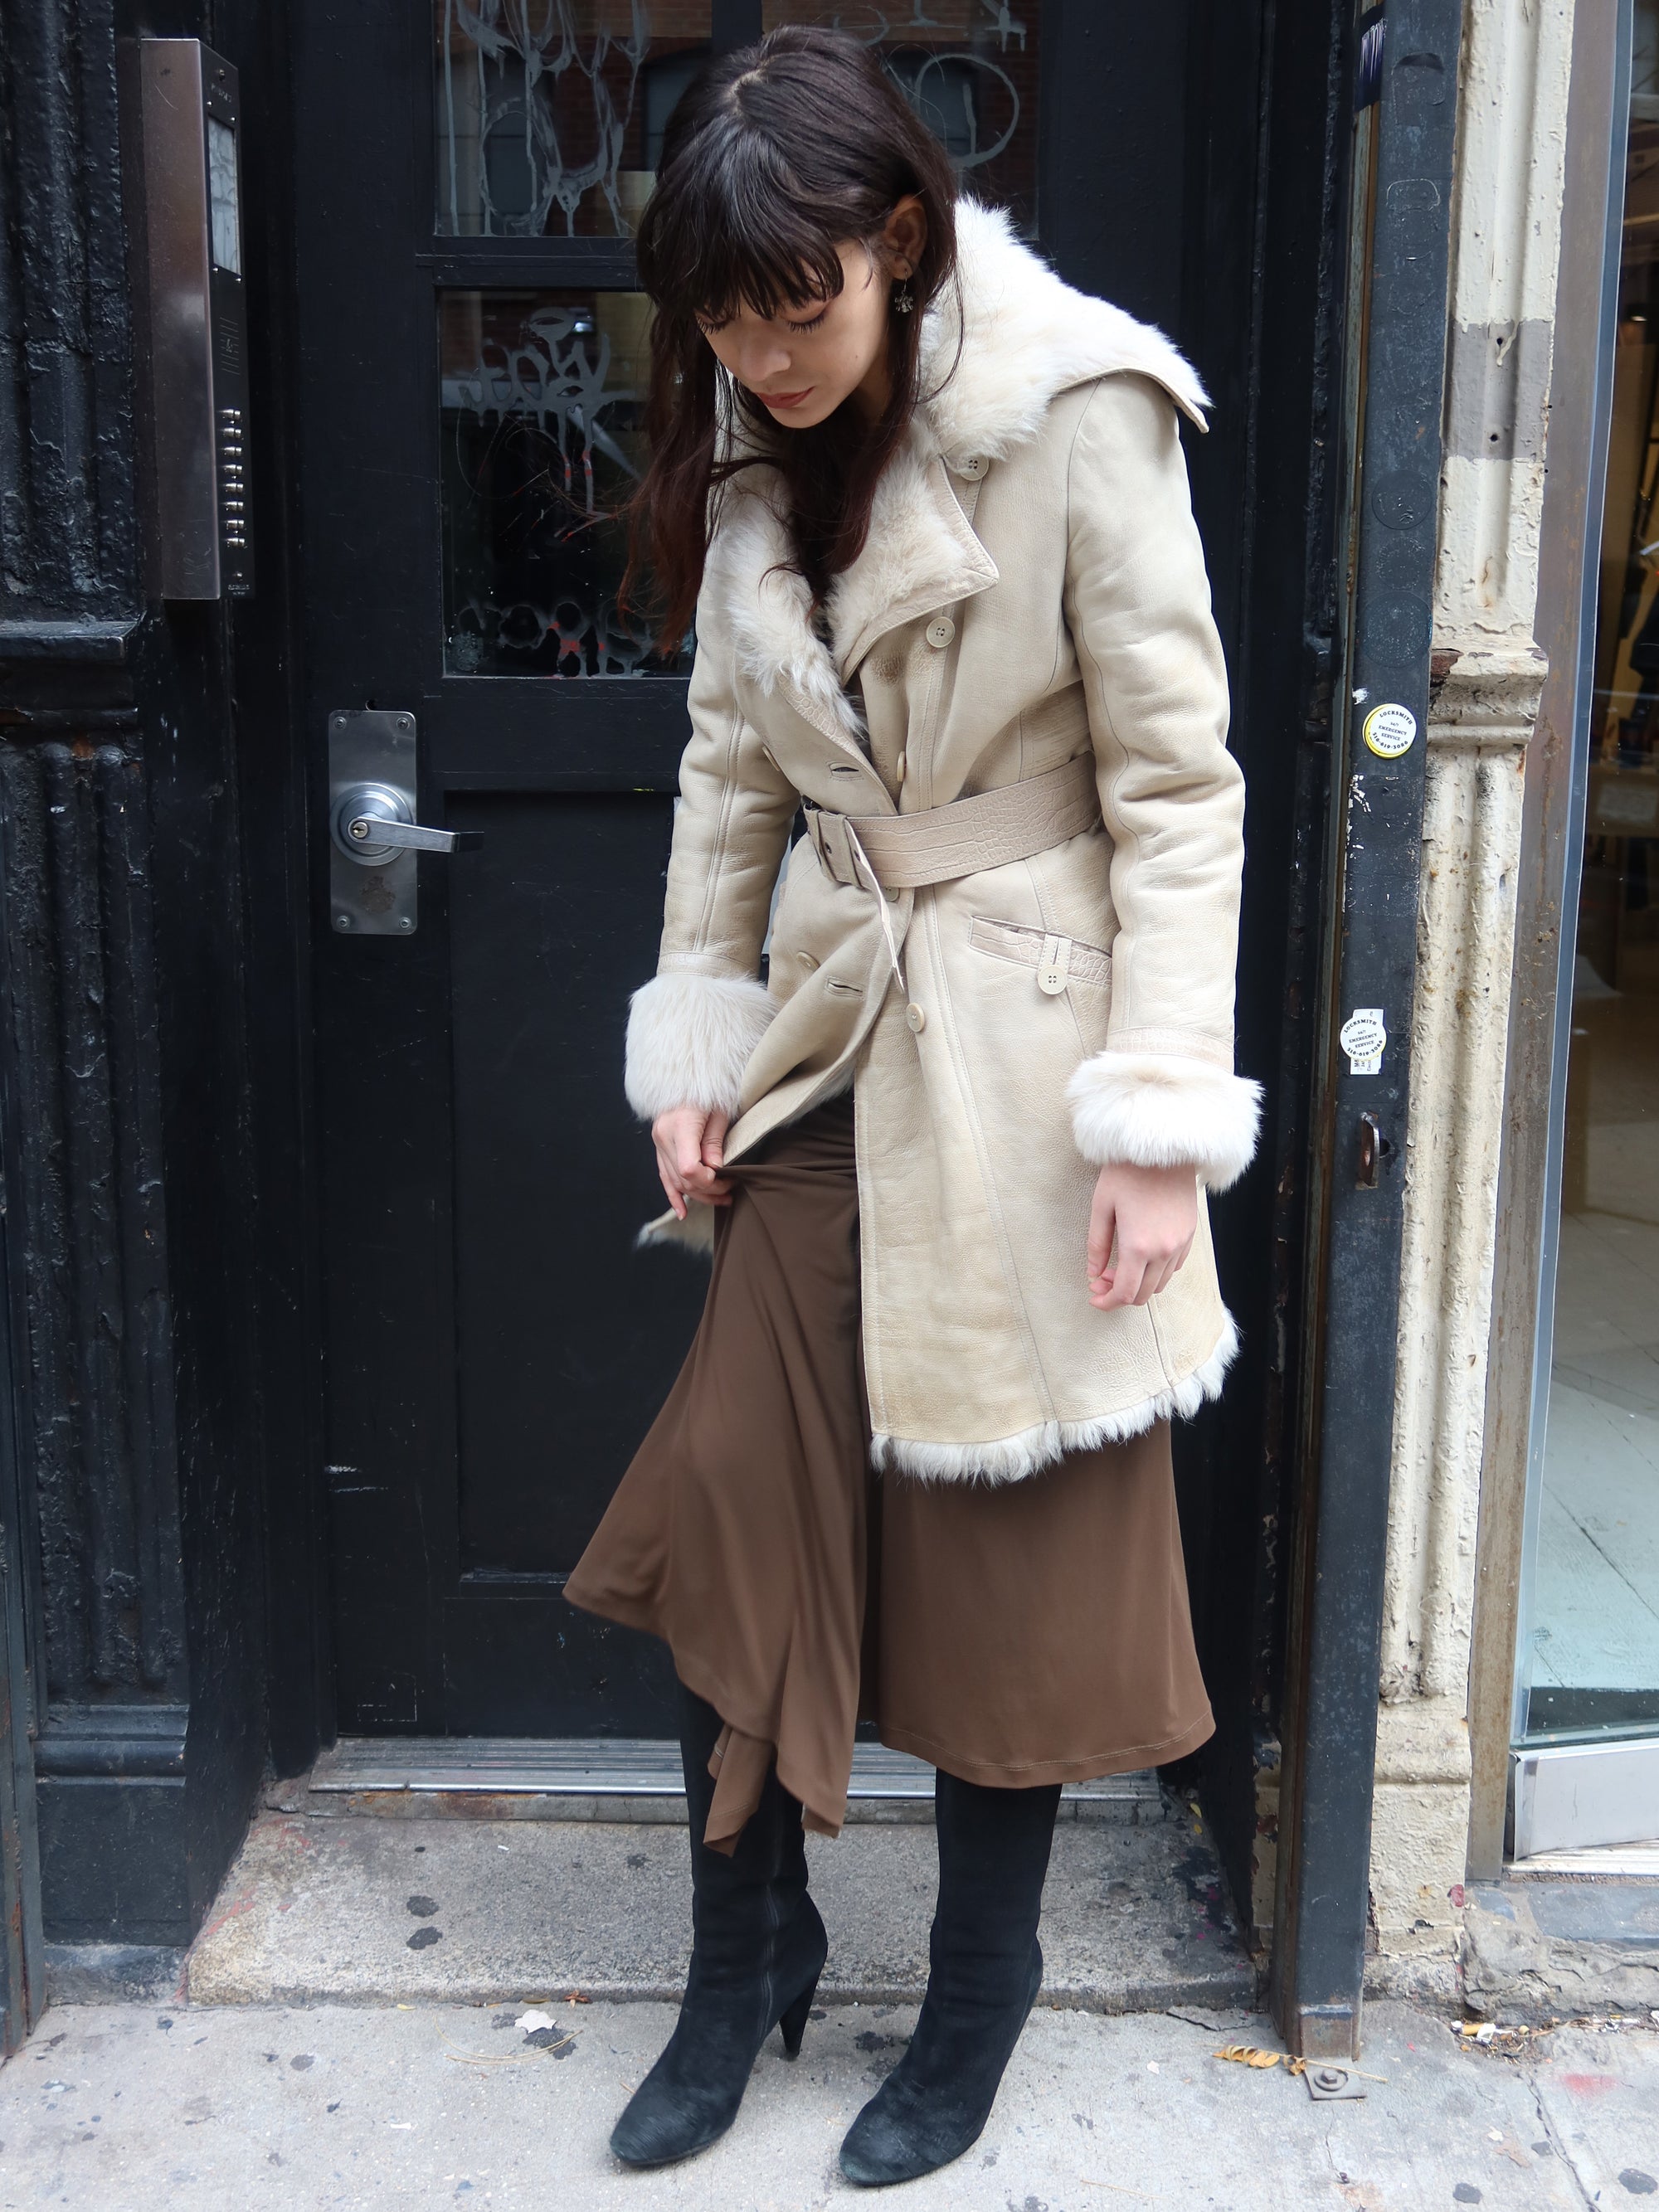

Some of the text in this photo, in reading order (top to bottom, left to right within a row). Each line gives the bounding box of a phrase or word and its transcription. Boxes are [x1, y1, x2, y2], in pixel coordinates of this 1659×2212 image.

[1379, 710, 1413, 725] LOCKSMITH
[1378, 725, 1408, 736] EMERGENCY
[1381, 732, 1401, 741] SERVICE
[1344, 1018, 1377, 1033] LOCKSMITH
[1349, 1033, 1378, 1043] EMERGENCY
[1355, 1040, 1374, 1048] SERVICE
